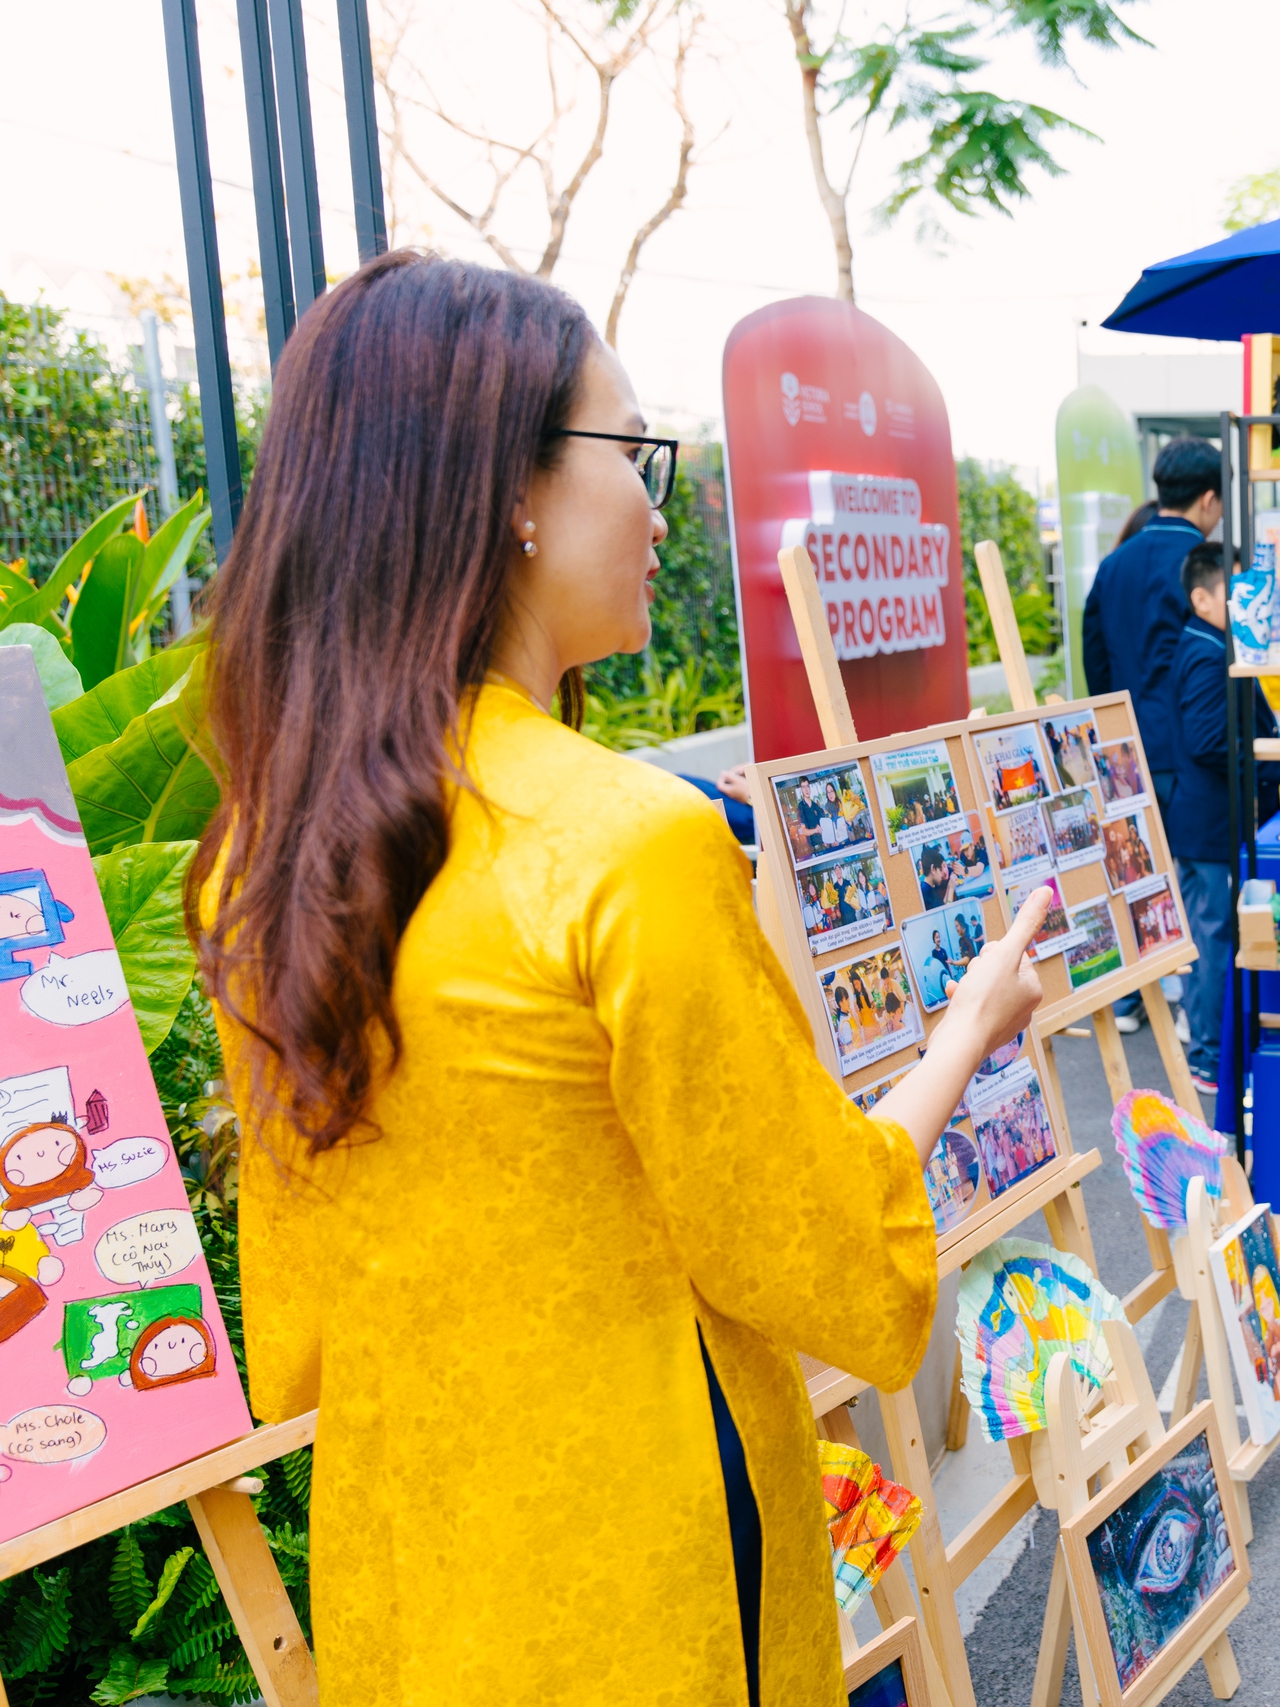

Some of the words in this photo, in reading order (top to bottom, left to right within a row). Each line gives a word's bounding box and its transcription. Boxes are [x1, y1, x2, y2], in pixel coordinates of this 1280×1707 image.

[833, 484, 899, 516] WELCOME
[901, 490, 918, 517] TO
[806, 532, 945, 583] SECONDARY
[827, 593, 941, 648] PROGRAM
[40, 974, 74, 989] Mr.
[67, 985, 114, 1008] Neels
[105, 1230, 134, 1245] Ms.
[139, 1220, 178, 1237] Mary
[15, 1422, 41, 1434] Ms.
[44, 1412, 86, 1428] Chole
